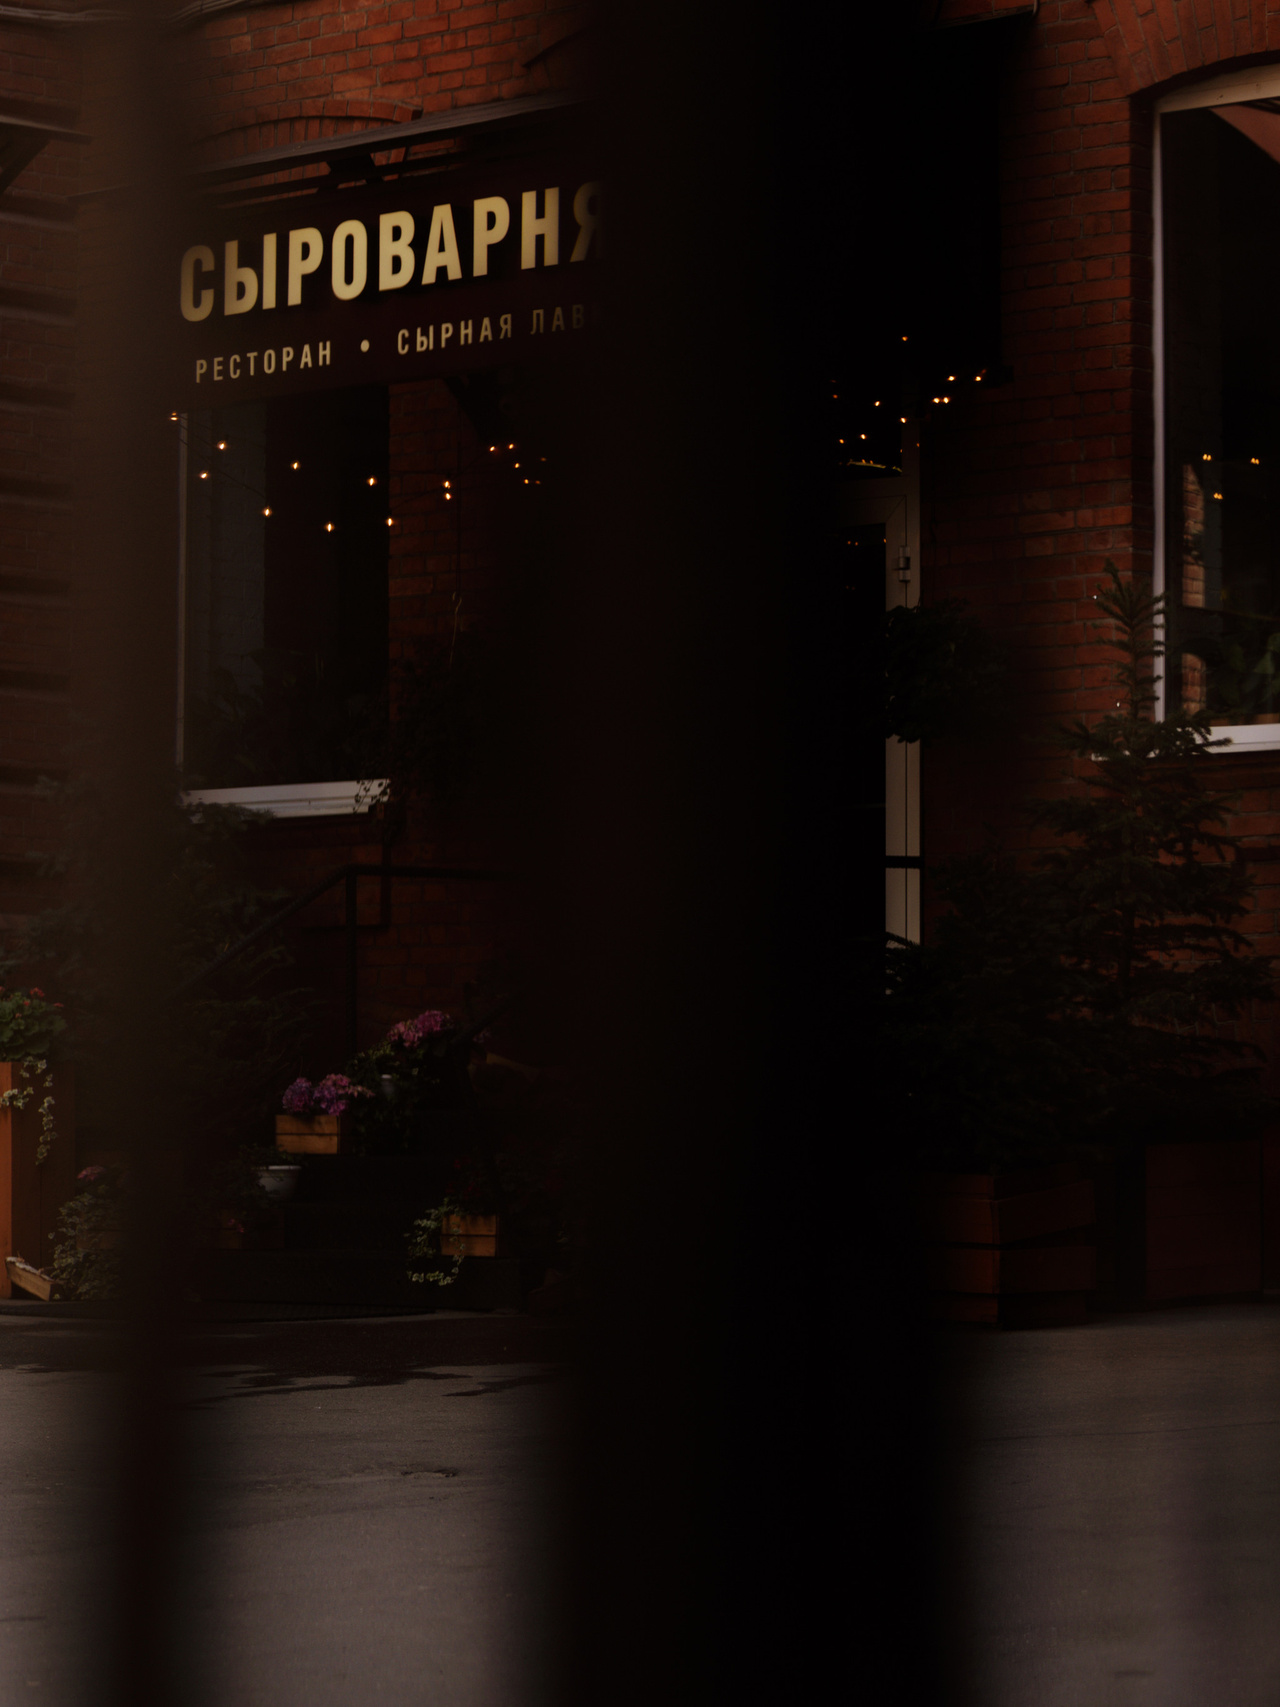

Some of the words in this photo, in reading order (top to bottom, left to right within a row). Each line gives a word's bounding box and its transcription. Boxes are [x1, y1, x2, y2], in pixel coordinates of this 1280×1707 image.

[179, 180, 605, 322] СЫРОВАРНЯ
[195, 340, 332, 384] РЕСТОРАН
[397, 313, 514, 355] СЫРНАЯ
[530, 303, 587, 336] ЛАВ
